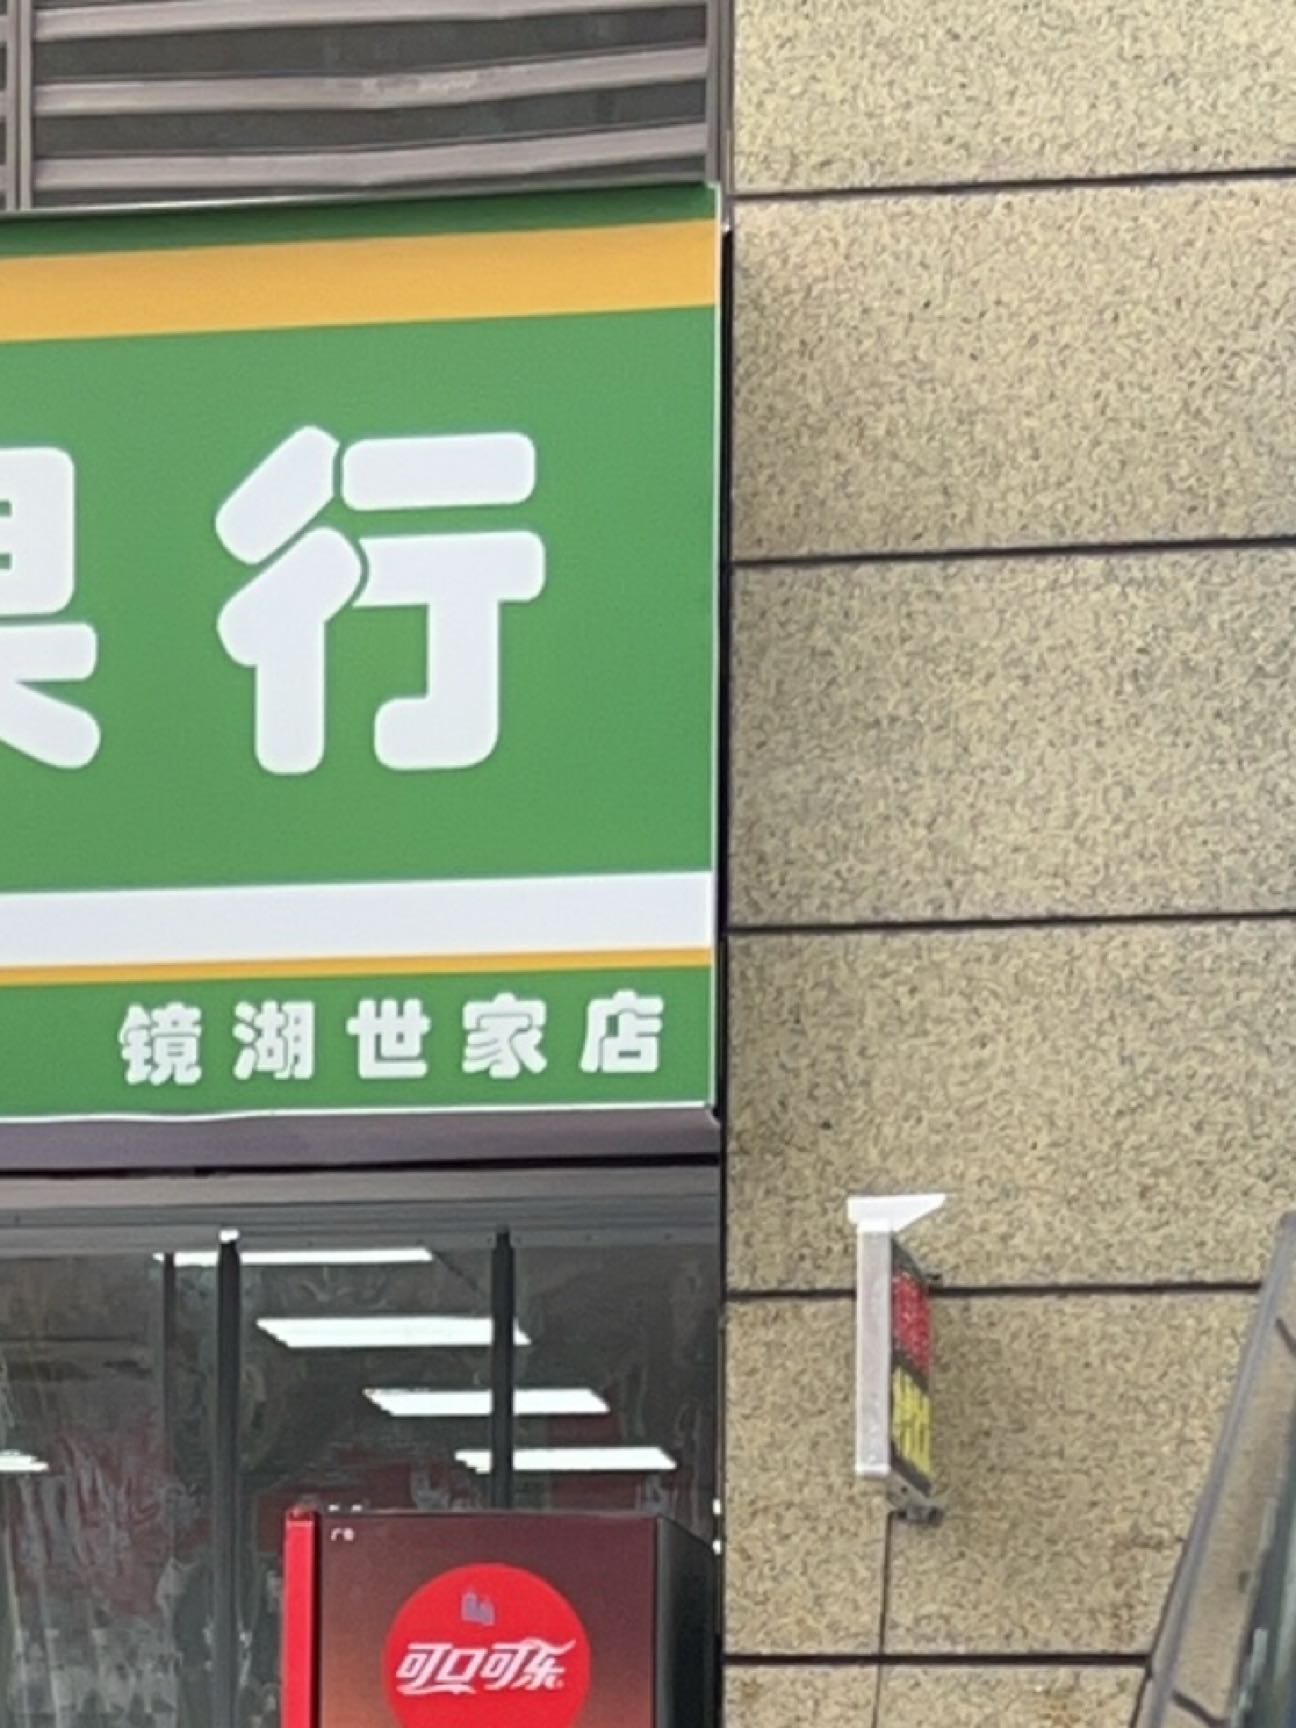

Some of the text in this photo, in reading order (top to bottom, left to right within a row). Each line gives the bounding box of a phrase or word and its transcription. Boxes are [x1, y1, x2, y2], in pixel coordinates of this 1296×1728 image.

[117, 989, 665, 1086] 镜湖世家店
[395, 1635, 577, 1695] 可口可乐
